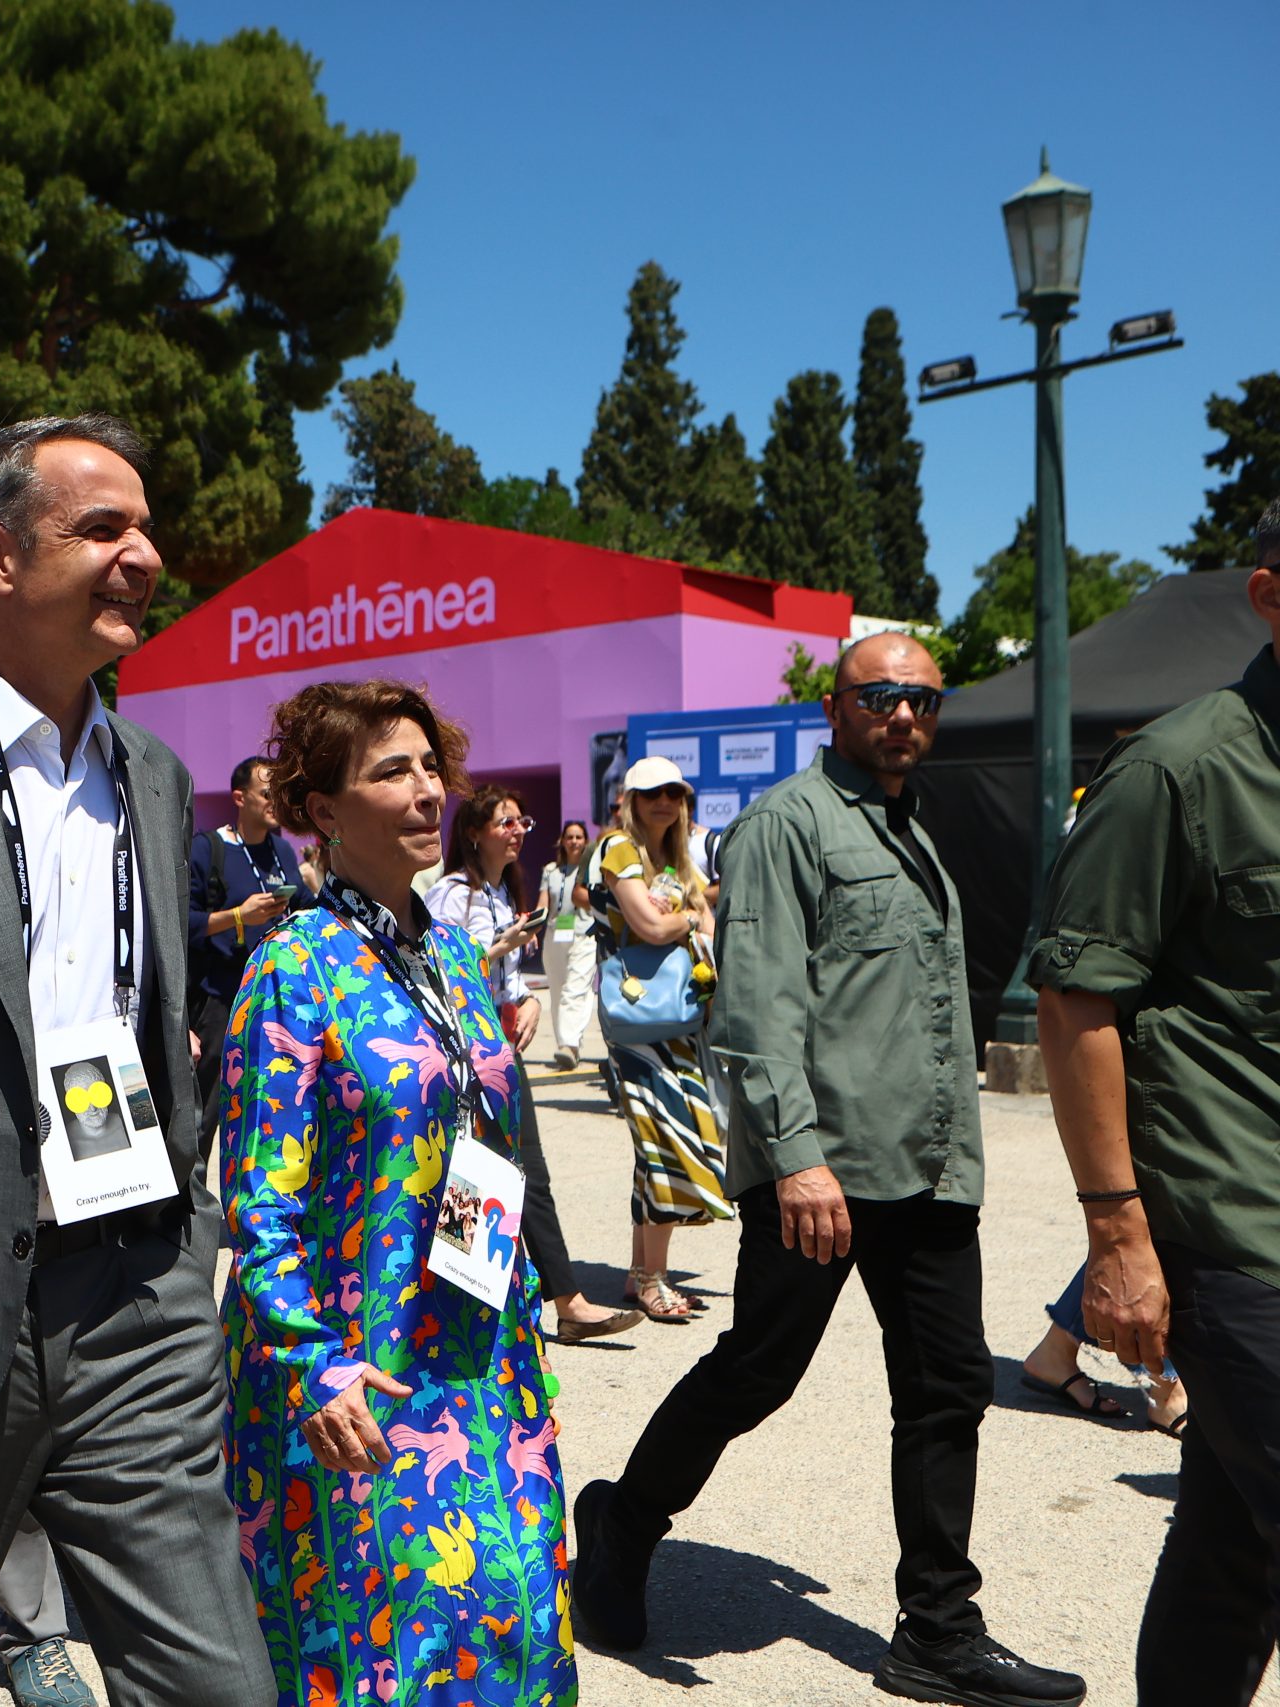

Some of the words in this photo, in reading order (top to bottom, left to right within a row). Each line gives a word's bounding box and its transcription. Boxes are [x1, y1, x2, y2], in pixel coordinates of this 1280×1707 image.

[229, 576, 496, 664] Panathēnea
[705, 802, 732, 816] DCG
[117, 849, 130, 912] Panathēnea
[76, 1196, 99, 1206] Crazy
[100, 1187, 129, 1200] enough
[139, 1182, 151, 1192] try.
